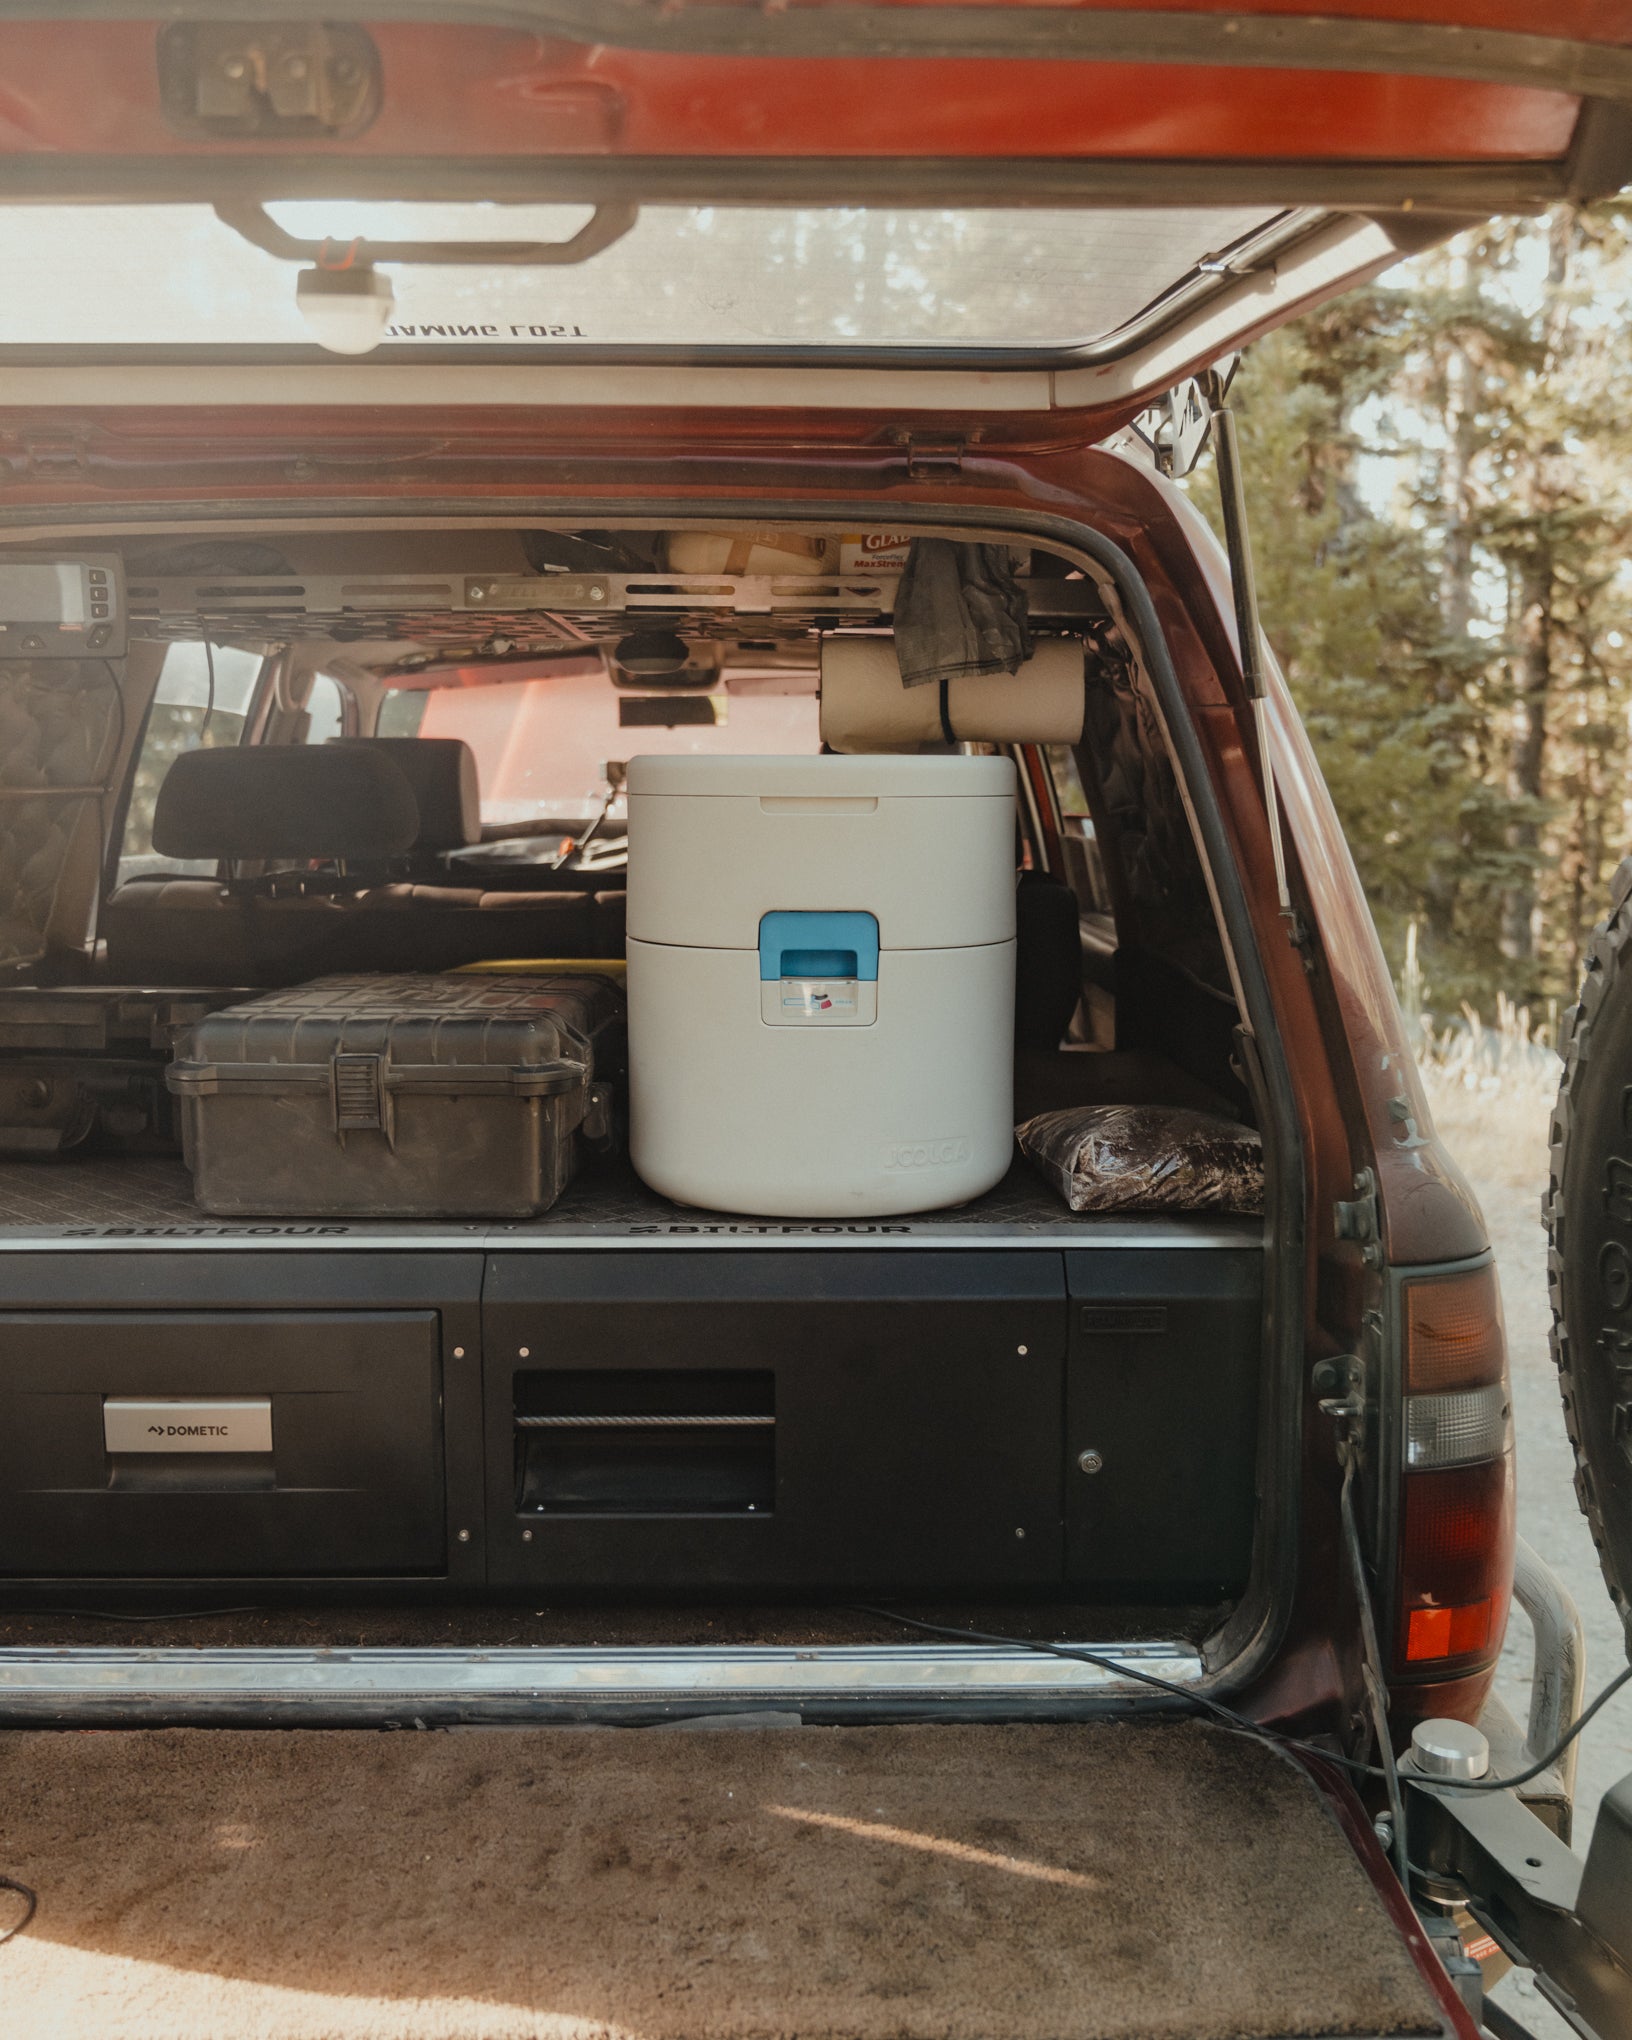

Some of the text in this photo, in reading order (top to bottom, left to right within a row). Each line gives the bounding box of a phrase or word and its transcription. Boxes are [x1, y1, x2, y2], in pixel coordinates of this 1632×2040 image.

[101, 1226, 351, 1236] BILTFOUR
[668, 1225, 912, 1234] BILTFOUR
[167, 1425, 229, 1436] DOMETIC
